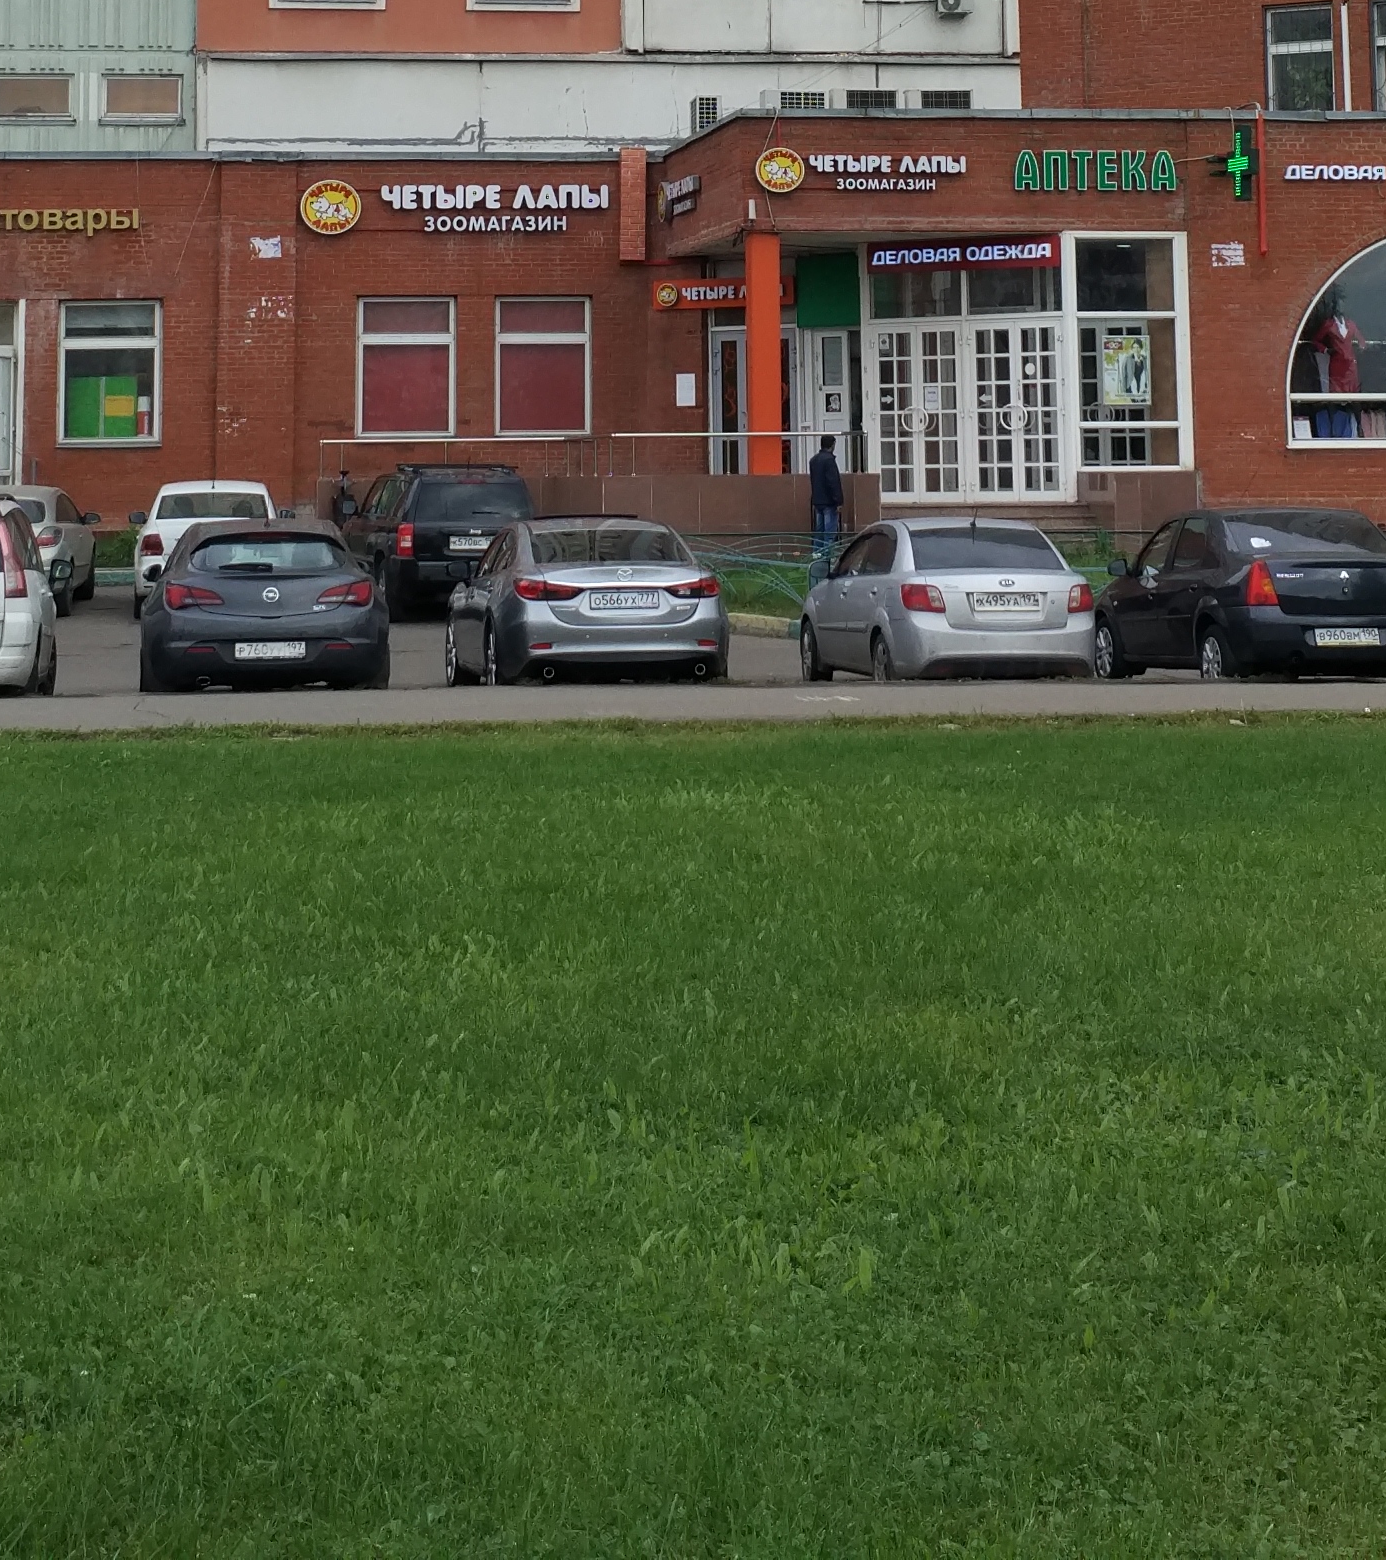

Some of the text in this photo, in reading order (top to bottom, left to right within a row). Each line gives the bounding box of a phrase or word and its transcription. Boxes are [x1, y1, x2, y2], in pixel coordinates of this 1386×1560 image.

[809, 154, 967, 173] ЧЕТЫРЕ ЛАПЫ
[1014, 149, 1177, 191] АПТЕКА
[1284, 165, 1386, 181] ДЕЛОВАЯ
[836, 178, 936, 190] ЗООМАГАЗИН
[380, 184, 609, 210] ЧЕТЫРЕ ЛАПЫ
[423, 215, 567, 232] ЗООМАГАЗИН
[871, 243, 1052, 266] ДЕЛОВАЯ ОДЕЖДА
[681, 285, 735, 301] ЧЕТЫРЕ
